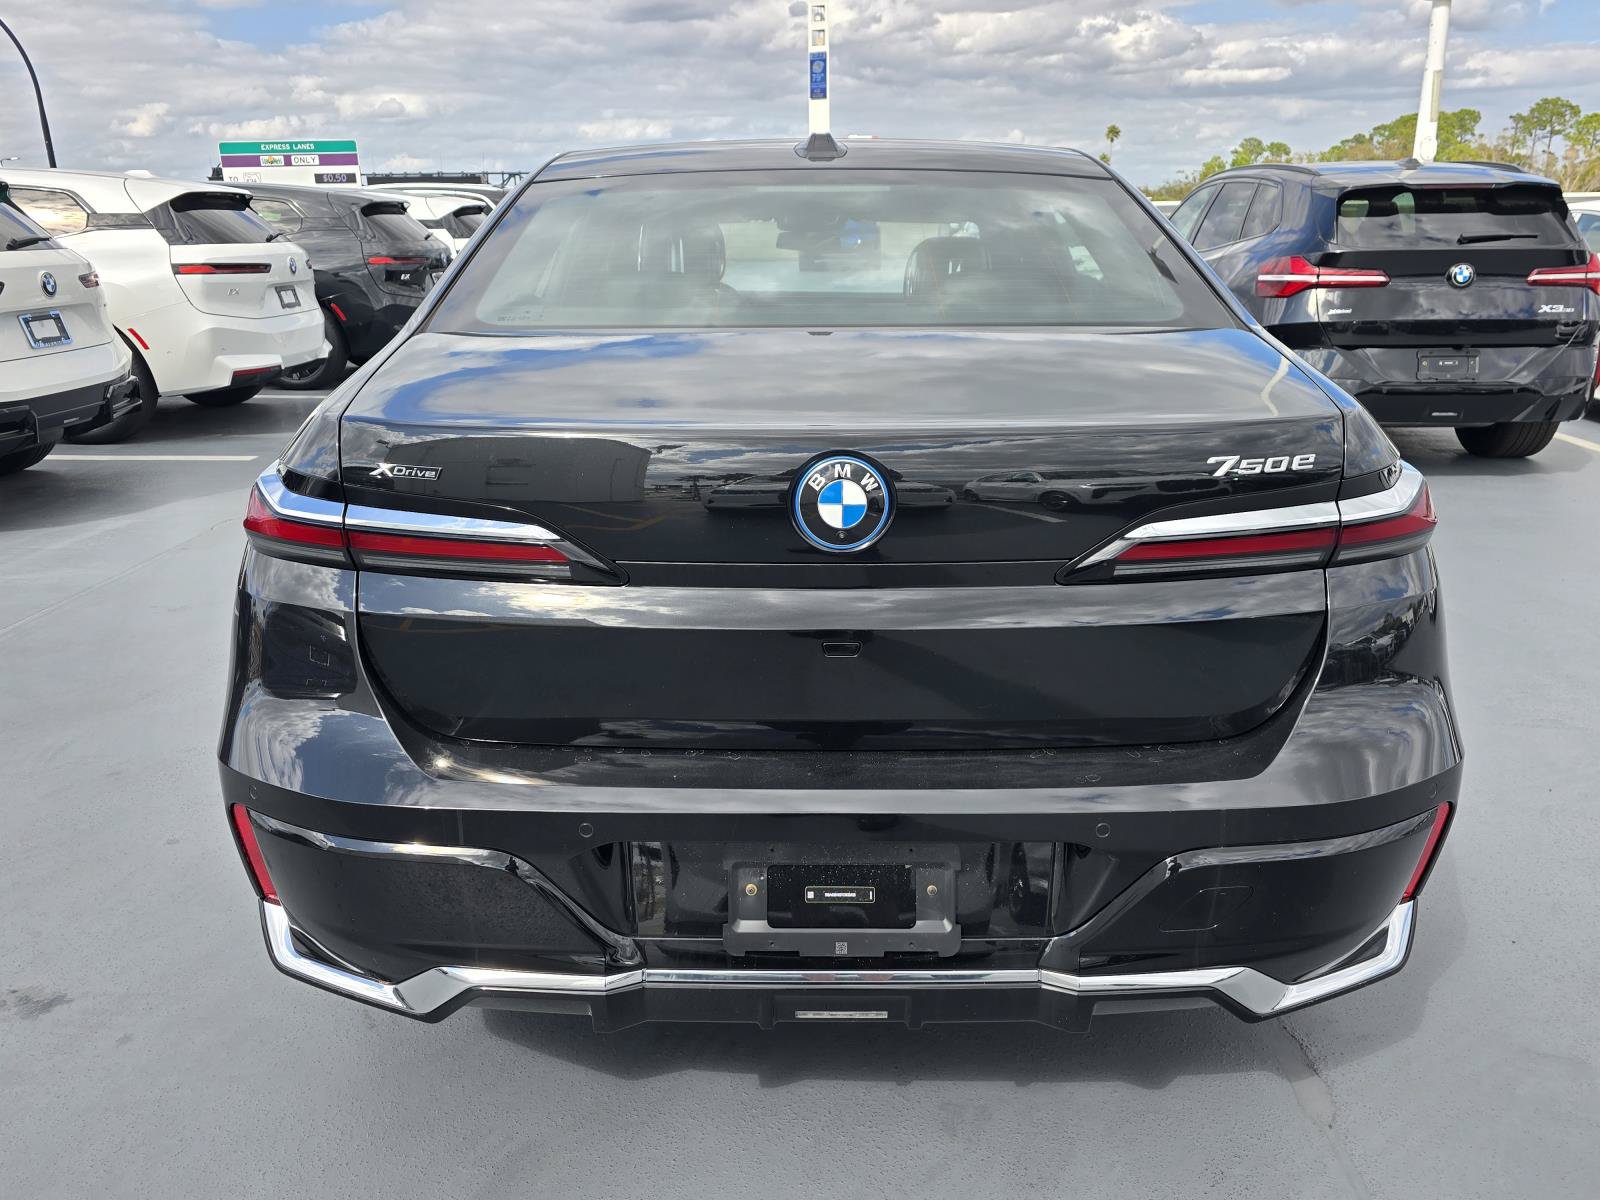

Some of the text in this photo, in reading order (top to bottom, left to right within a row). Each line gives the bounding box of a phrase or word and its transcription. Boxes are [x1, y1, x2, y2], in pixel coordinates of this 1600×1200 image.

[294, 156, 315, 164] ONLY
[323, 173, 347, 182] $0.50
[1206, 453, 1316, 477] 750e
[808, 463, 879, 492] BMW
